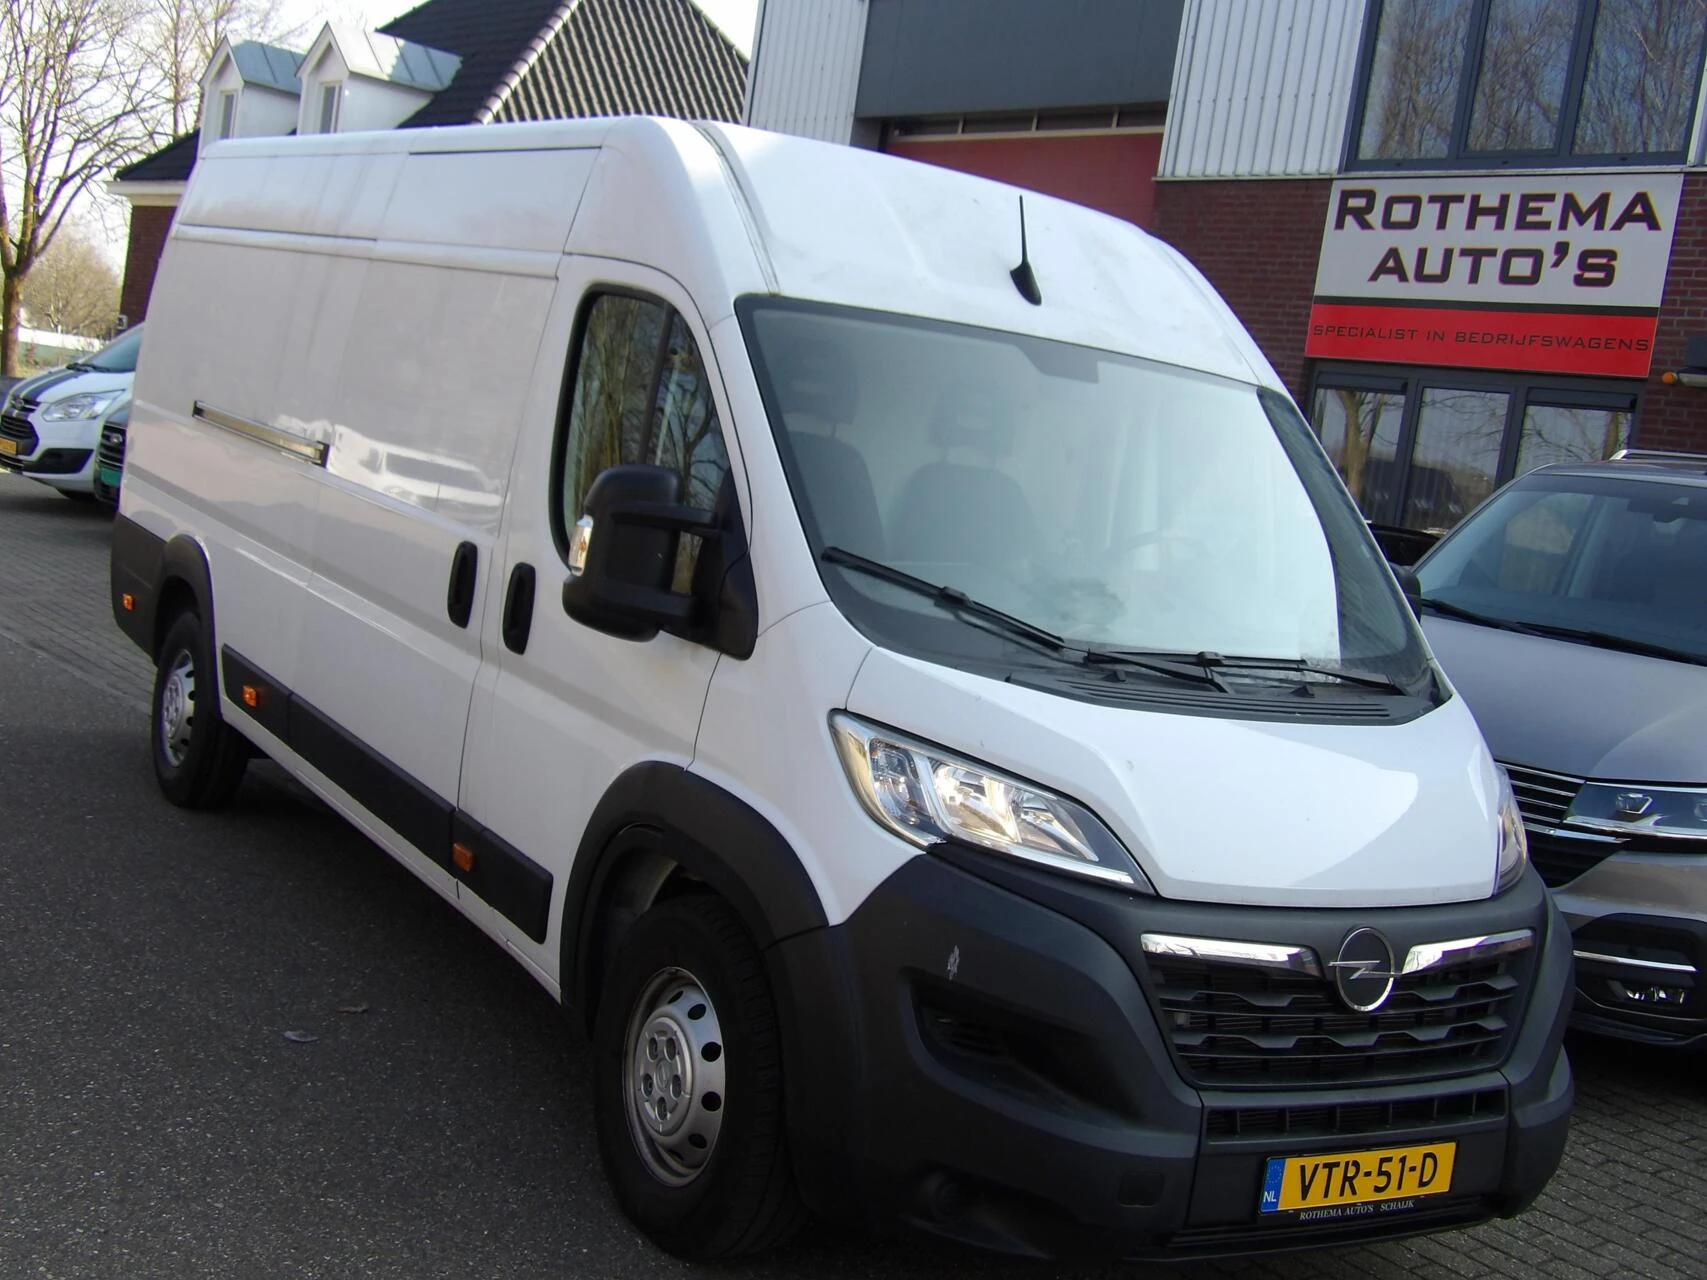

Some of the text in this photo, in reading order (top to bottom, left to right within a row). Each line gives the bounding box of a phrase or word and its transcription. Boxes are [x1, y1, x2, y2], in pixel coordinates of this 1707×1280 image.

[1334, 188, 1662, 231] ROTHEMA
[1368, 241, 1618, 288] AUTO'S
[1313, 325, 1649, 352] SPECIALIST IN BEDRIJFSWAGENS
[1299, 1151, 1438, 1201] VTR-51-D
[1263, 1191, 1277, 1203] NL
[1299, 1208, 1342, 1221] ROTHEMA
[1344, 1203, 1374, 1215] AUTO'S
